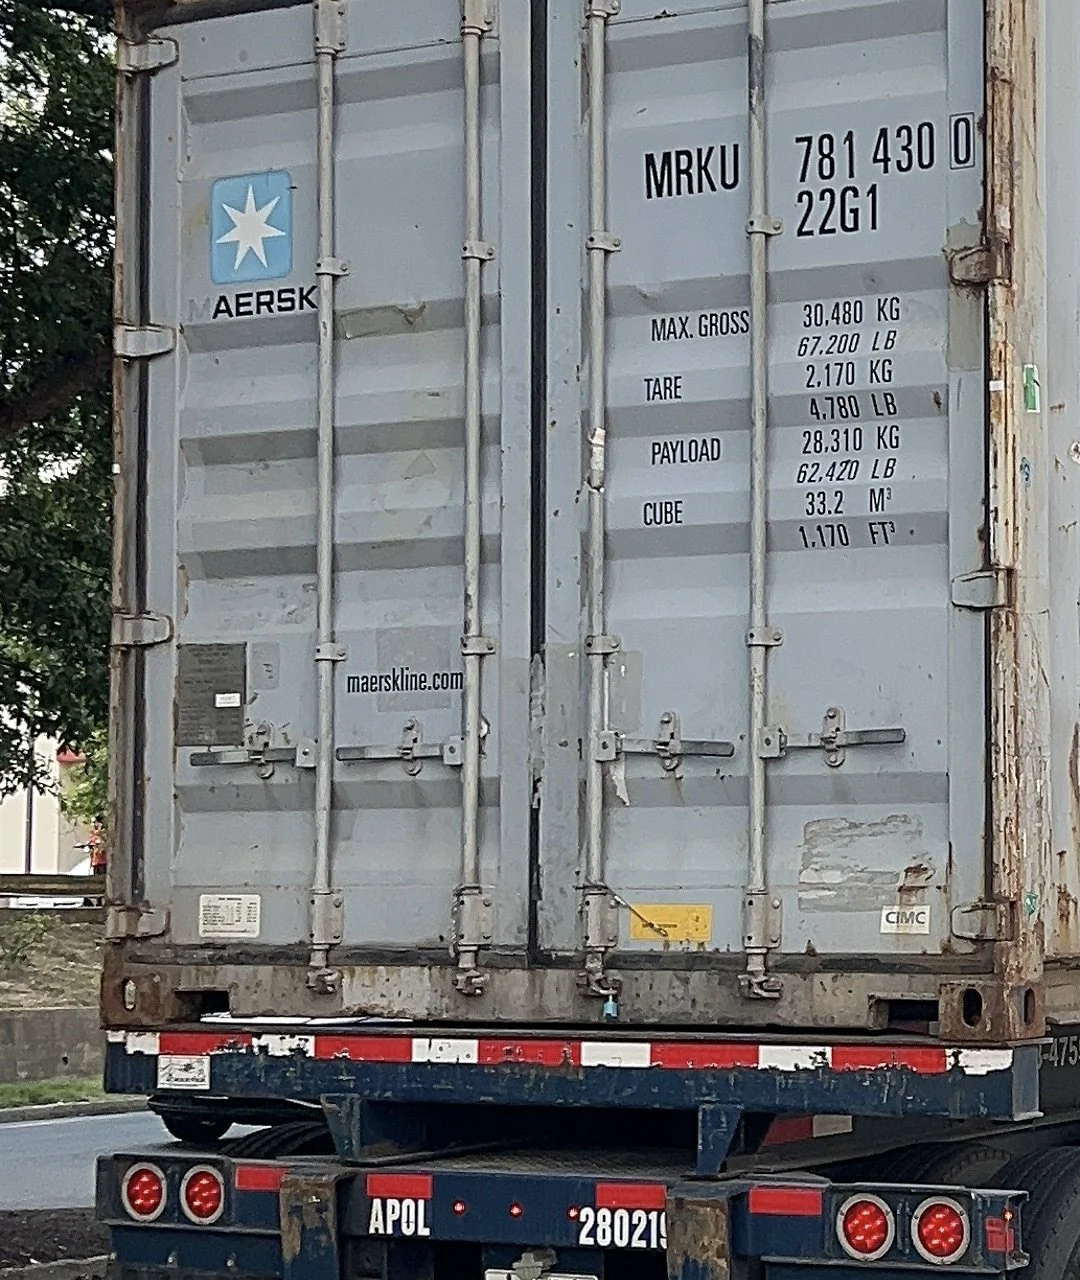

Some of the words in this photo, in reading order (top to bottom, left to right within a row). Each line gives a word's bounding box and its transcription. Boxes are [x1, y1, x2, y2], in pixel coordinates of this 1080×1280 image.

[645, 143, 740, 199] MRKU
[795, 130, 856, 183] 781
[872, 122, 935, 175] 430
[953, 117, 970, 165] 0
[796, 183, 879, 237] 22G1
[651, 317, 694, 342] MAX.
[698, 310, 750, 338] GROSS
[803, 299, 863, 328] 30.480
[877, 296, 900, 322] KG
[797, 332, 860, 358] 67.200
[871, 330, 897, 352] LB
[644, 376, 682, 401] TARE
[805, 362, 855, 389] 2.170
[869, 360, 893, 384] KG
[810, 394, 860, 421] 4.780
[871, 392, 897, 417] LB
[651, 438, 721, 466] PAYLOAD
[802, 428, 862, 455] 28.310
[876, 425, 900, 450] KG
[796, 460, 859, 484] 62.420
[870, 458, 896, 480] LB
[643, 501, 683, 526] CUBE
[805, 489, 844, 516] 33.2
[799, 524, 849, 548] 1.170
[346, 666, 464, 693] maerskline.com
[886, 911, 926, 925] CIMC
[368, 1198, 431, 1237] APOL
